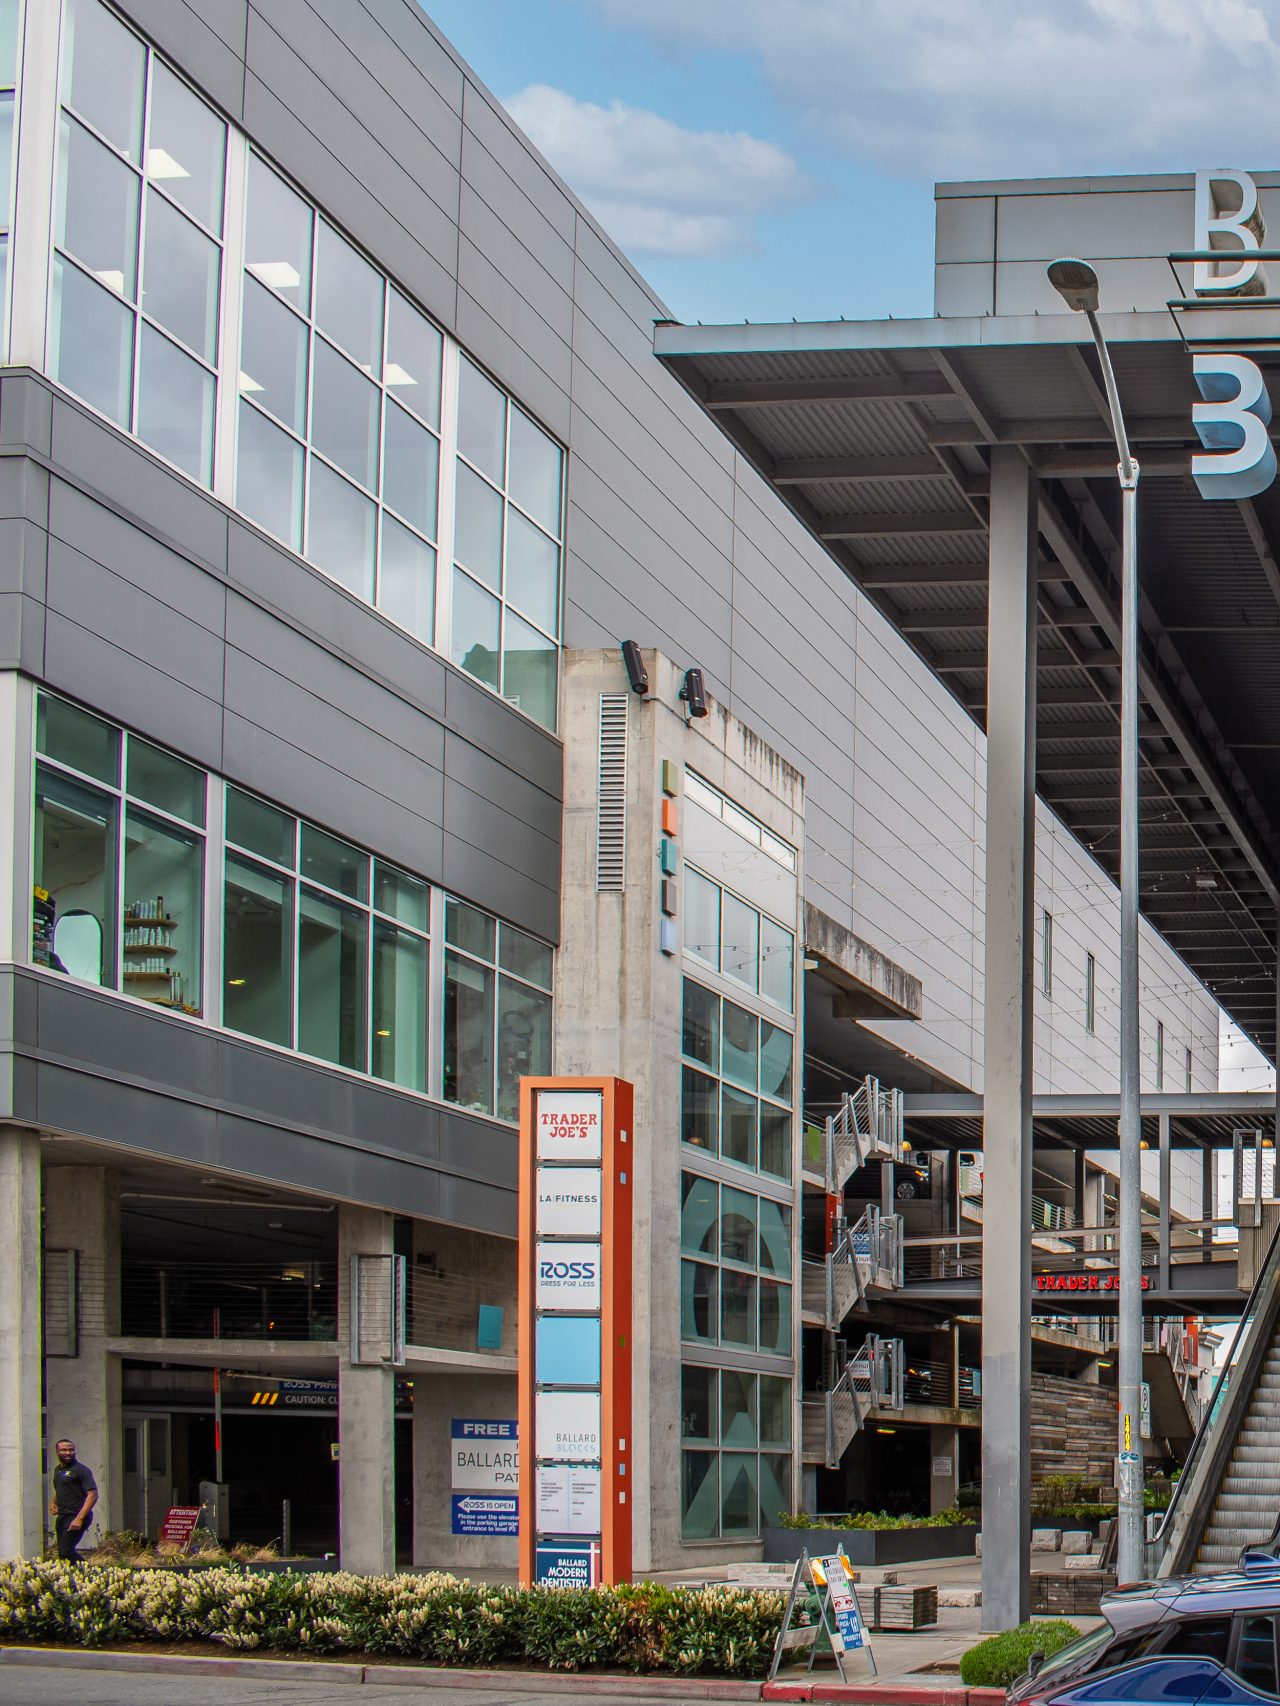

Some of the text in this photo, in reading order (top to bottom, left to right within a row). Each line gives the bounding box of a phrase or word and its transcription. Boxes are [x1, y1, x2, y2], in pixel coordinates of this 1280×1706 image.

[541, 1113, 598, 1126] TRADER
[549, 1126, 589, 1138] JOE'S
[555, 1194, 598, 1203] FITNESS
[852, 1233, 874, 1241] ROS
[540, 1262, 595, 1279] ROSS
[578, 1280, 596, 1288] LESS
[1036, 1275, 1149, 1290] TRADER JOS
[463, 1423, 510, 1435] FREE
[556, 1433, 597, 1443] BALLARD
[556, 1444, 597, 1453] BLOCKS
[463, 1501, 486, 1509] ROSS
[476, 1520, 498, 1528] parking
[558, 1558, 587, 1567] BALLARD
[547, 1566, 588, 1578] MODERN
[541, 1577, 587, 1589] DENTISTRY
